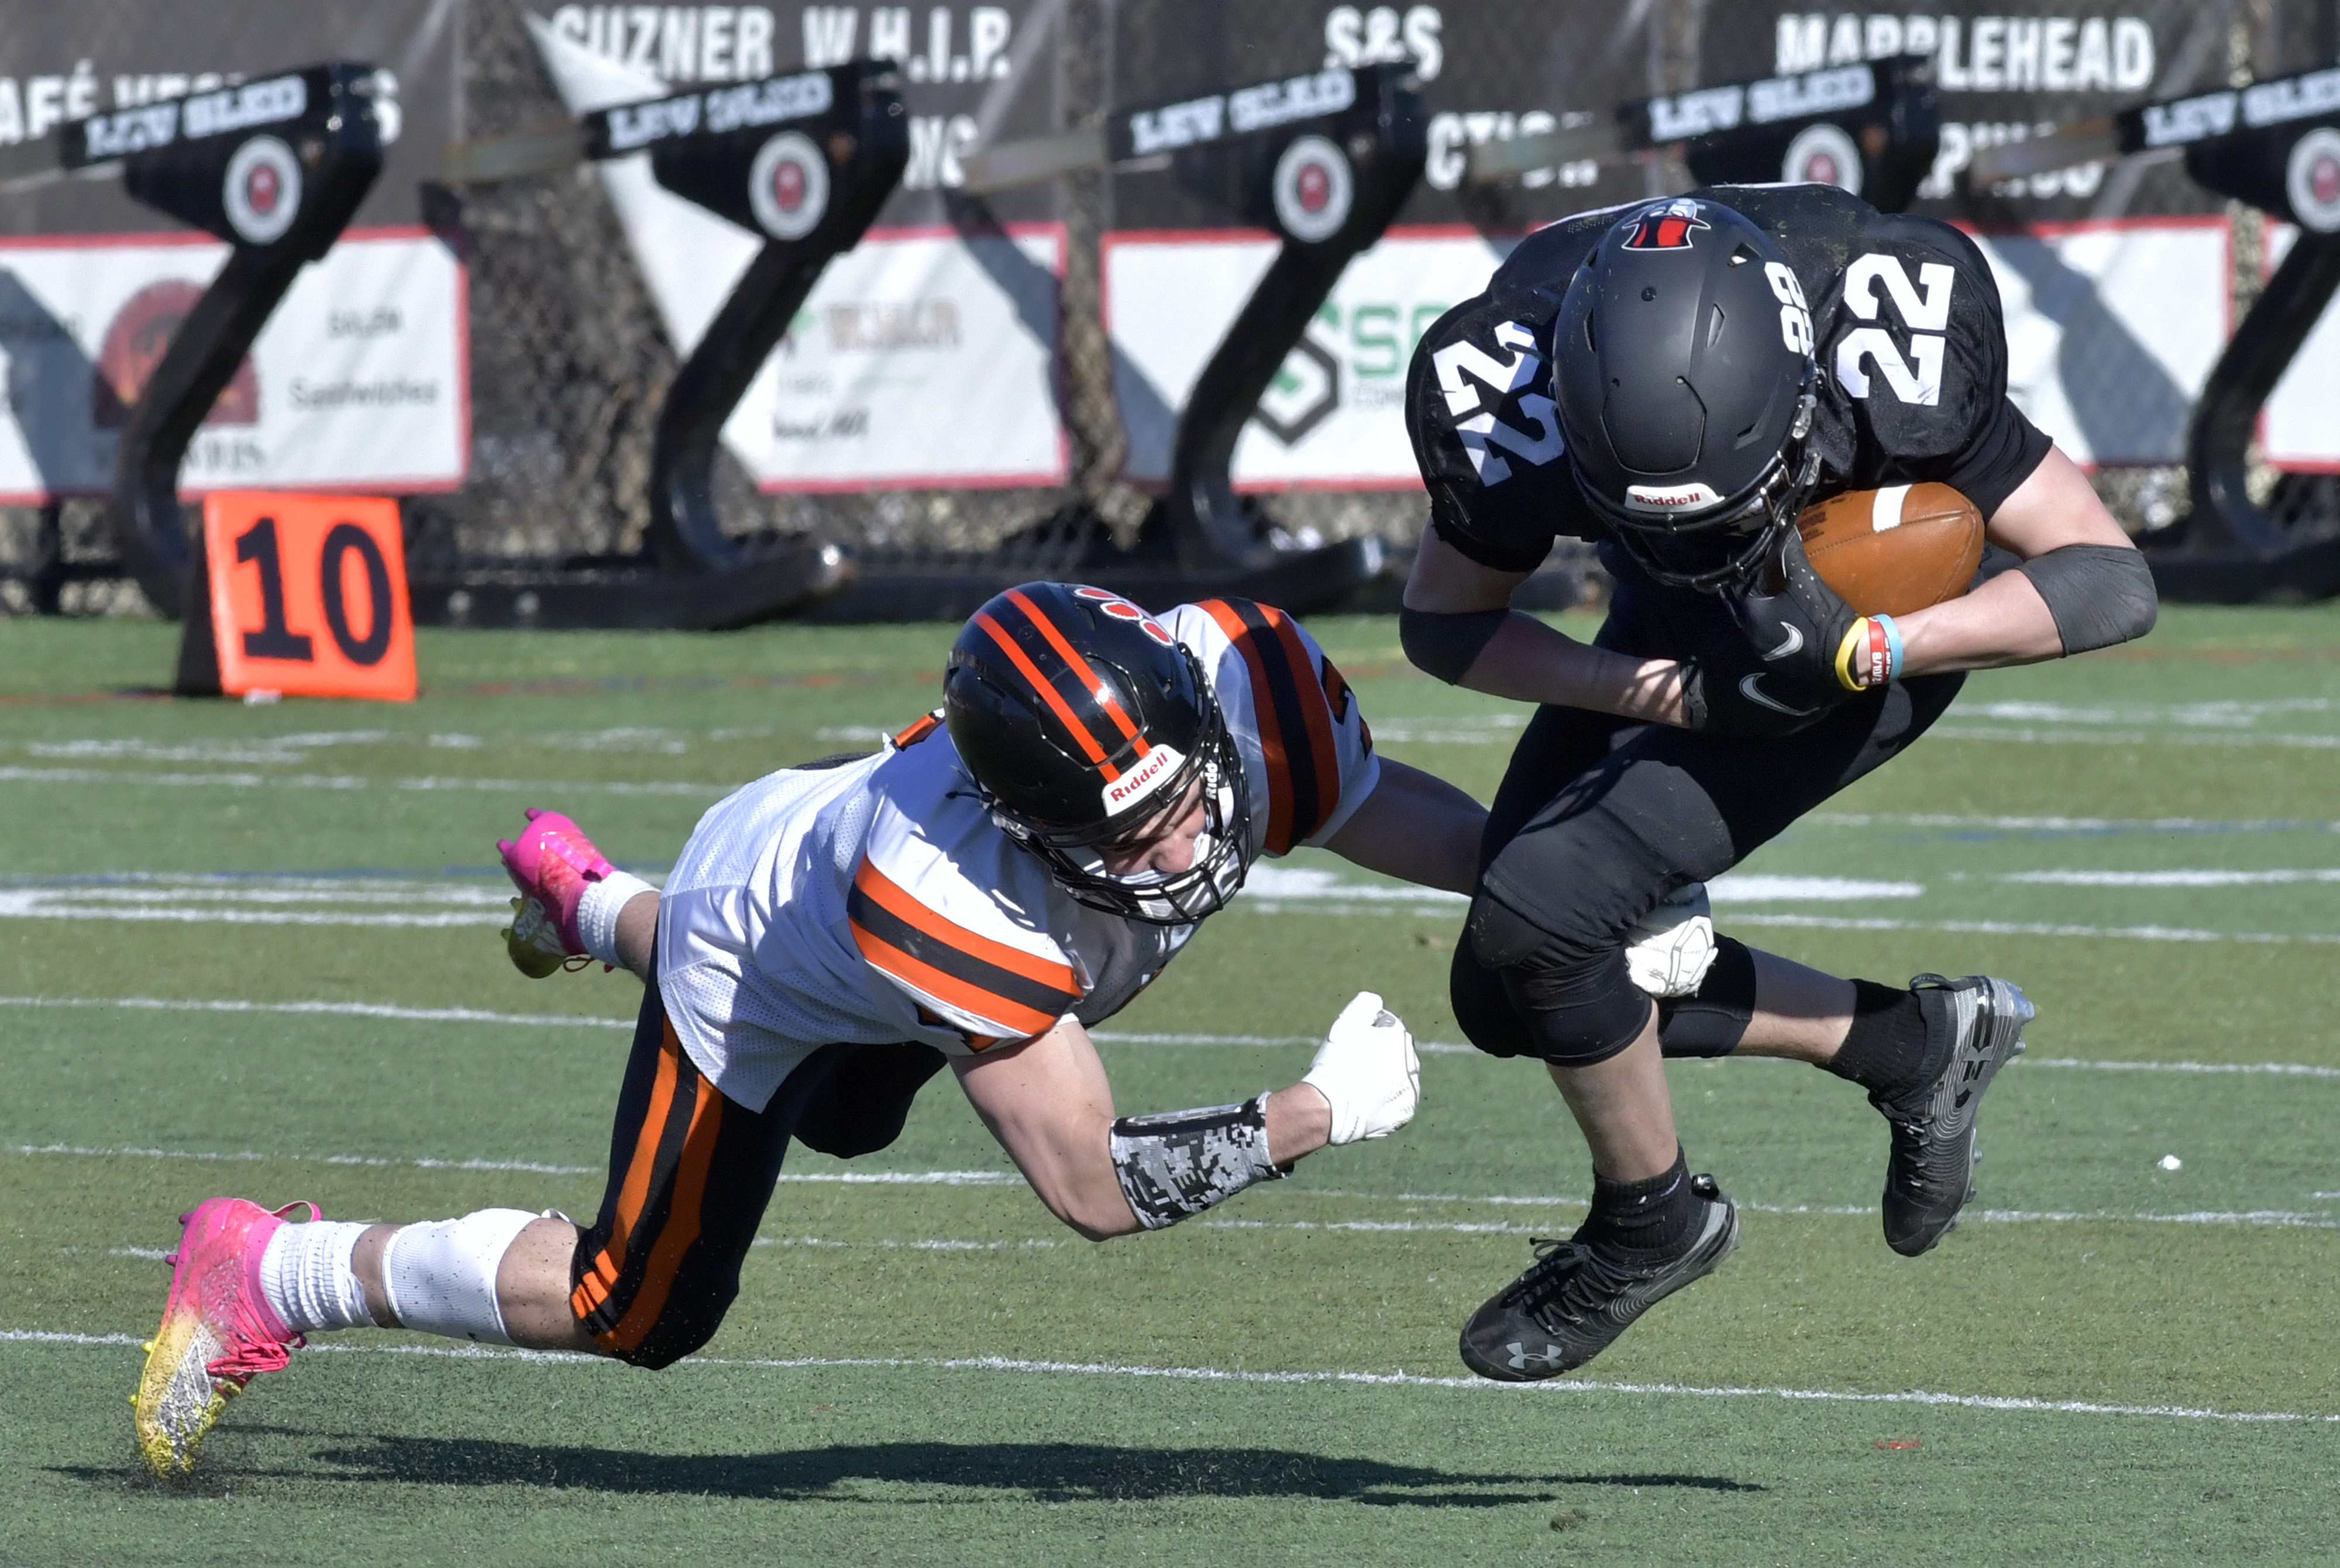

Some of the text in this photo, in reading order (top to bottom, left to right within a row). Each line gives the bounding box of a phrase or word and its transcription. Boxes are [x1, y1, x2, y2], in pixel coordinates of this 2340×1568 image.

[802, 5, 1012, 83] WH.I.P.
[1324, 5, 1443, 82] S&S
[85, 104, 177, 157] LEV
[183, 75, 307, 139] SLED
[607, 71, 833, 149] LEV SLED
[1130, 67, 1355, 154] LEV SLED
[1648, 65, 1875, 142] LEV SLED
[2143, 91, 2238, 146] LEV
[1836, 252, 1955, 406] 22
[1433, 321, 1565, 487] 22
[1634, 492, 1701, 505] Riddell
[236, 516, 393, 667] 10
[1110, 752, 1168, 802] Riddell
